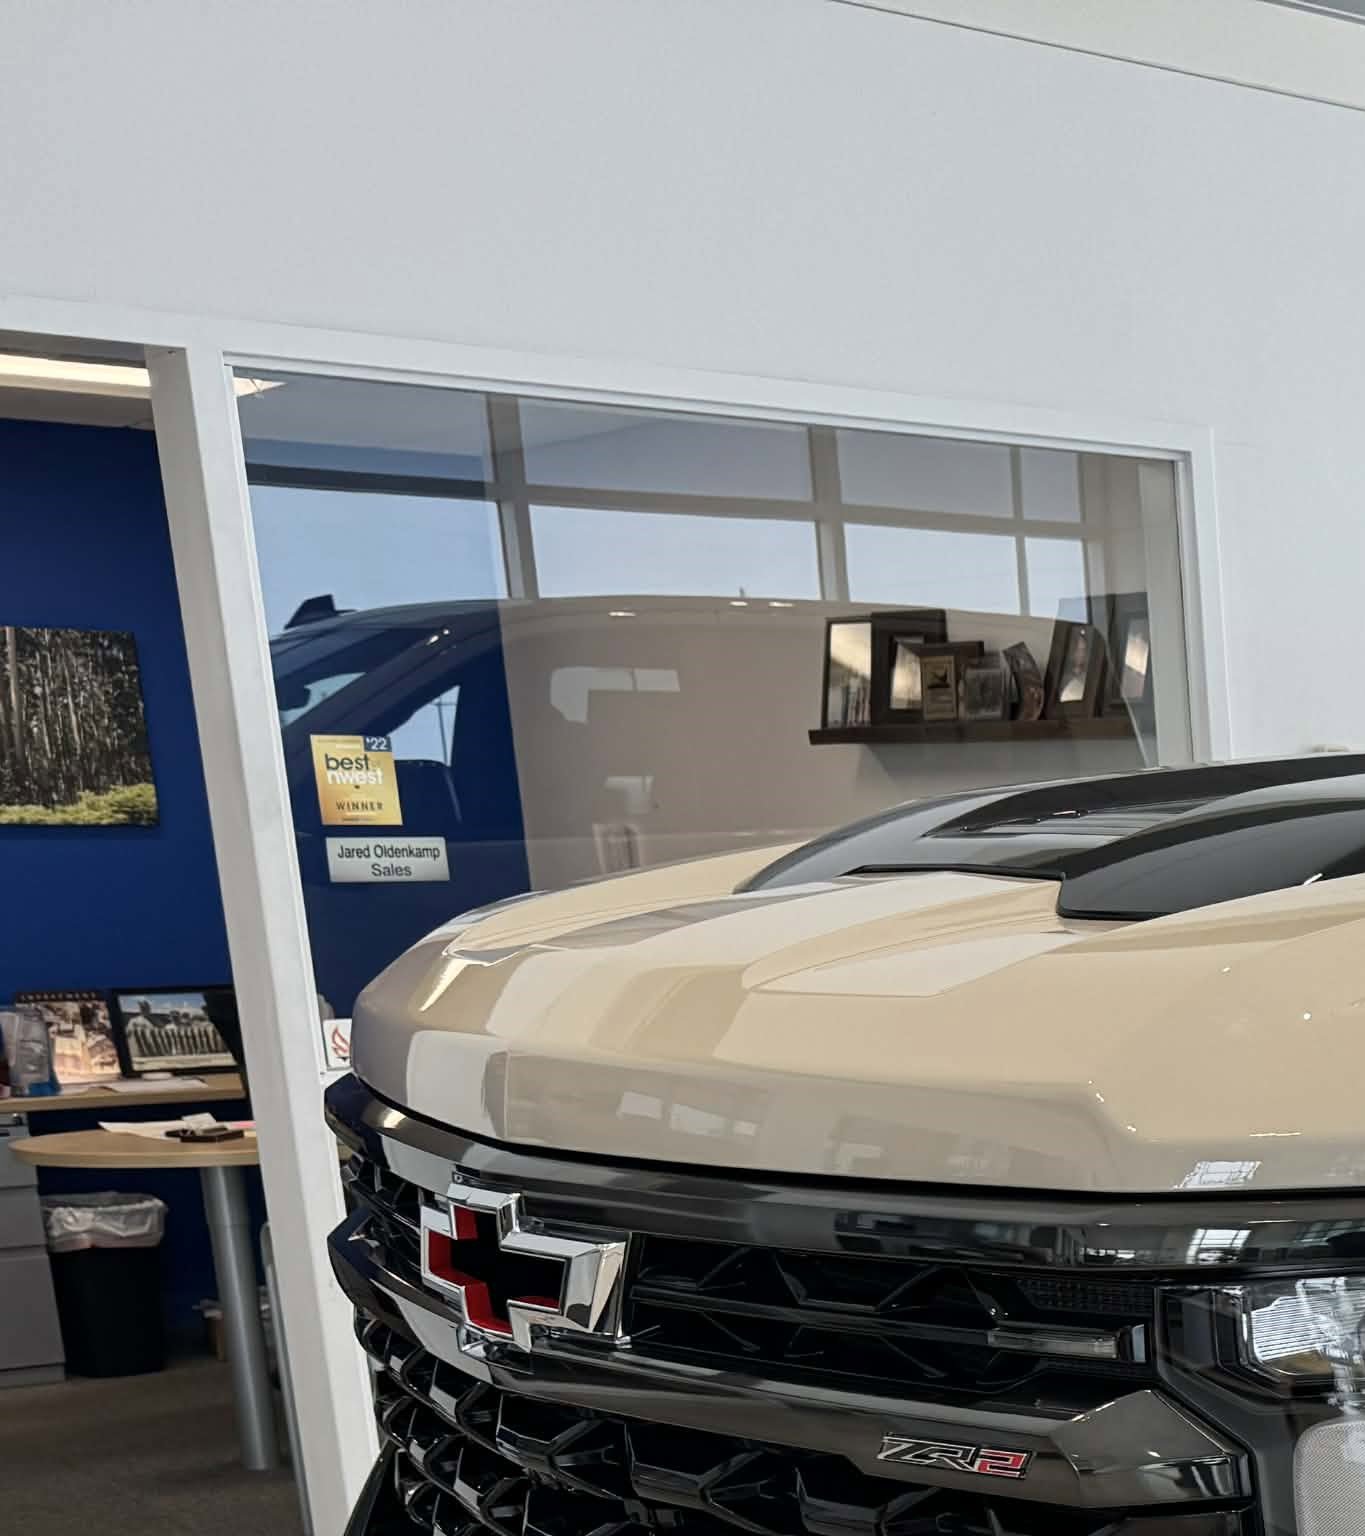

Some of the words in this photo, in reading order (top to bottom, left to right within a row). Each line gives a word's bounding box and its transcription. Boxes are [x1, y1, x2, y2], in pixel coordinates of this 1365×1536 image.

[325, 753, 370, 770] best
[336, 800, 383, 811] WINNER
[337, 844, 371, 859] Jared
[373, 844, 441, 861] Oldenkamp
[371, 863, 412, 877] Sales
[877, 1434, 1033, 1479] ZR2
